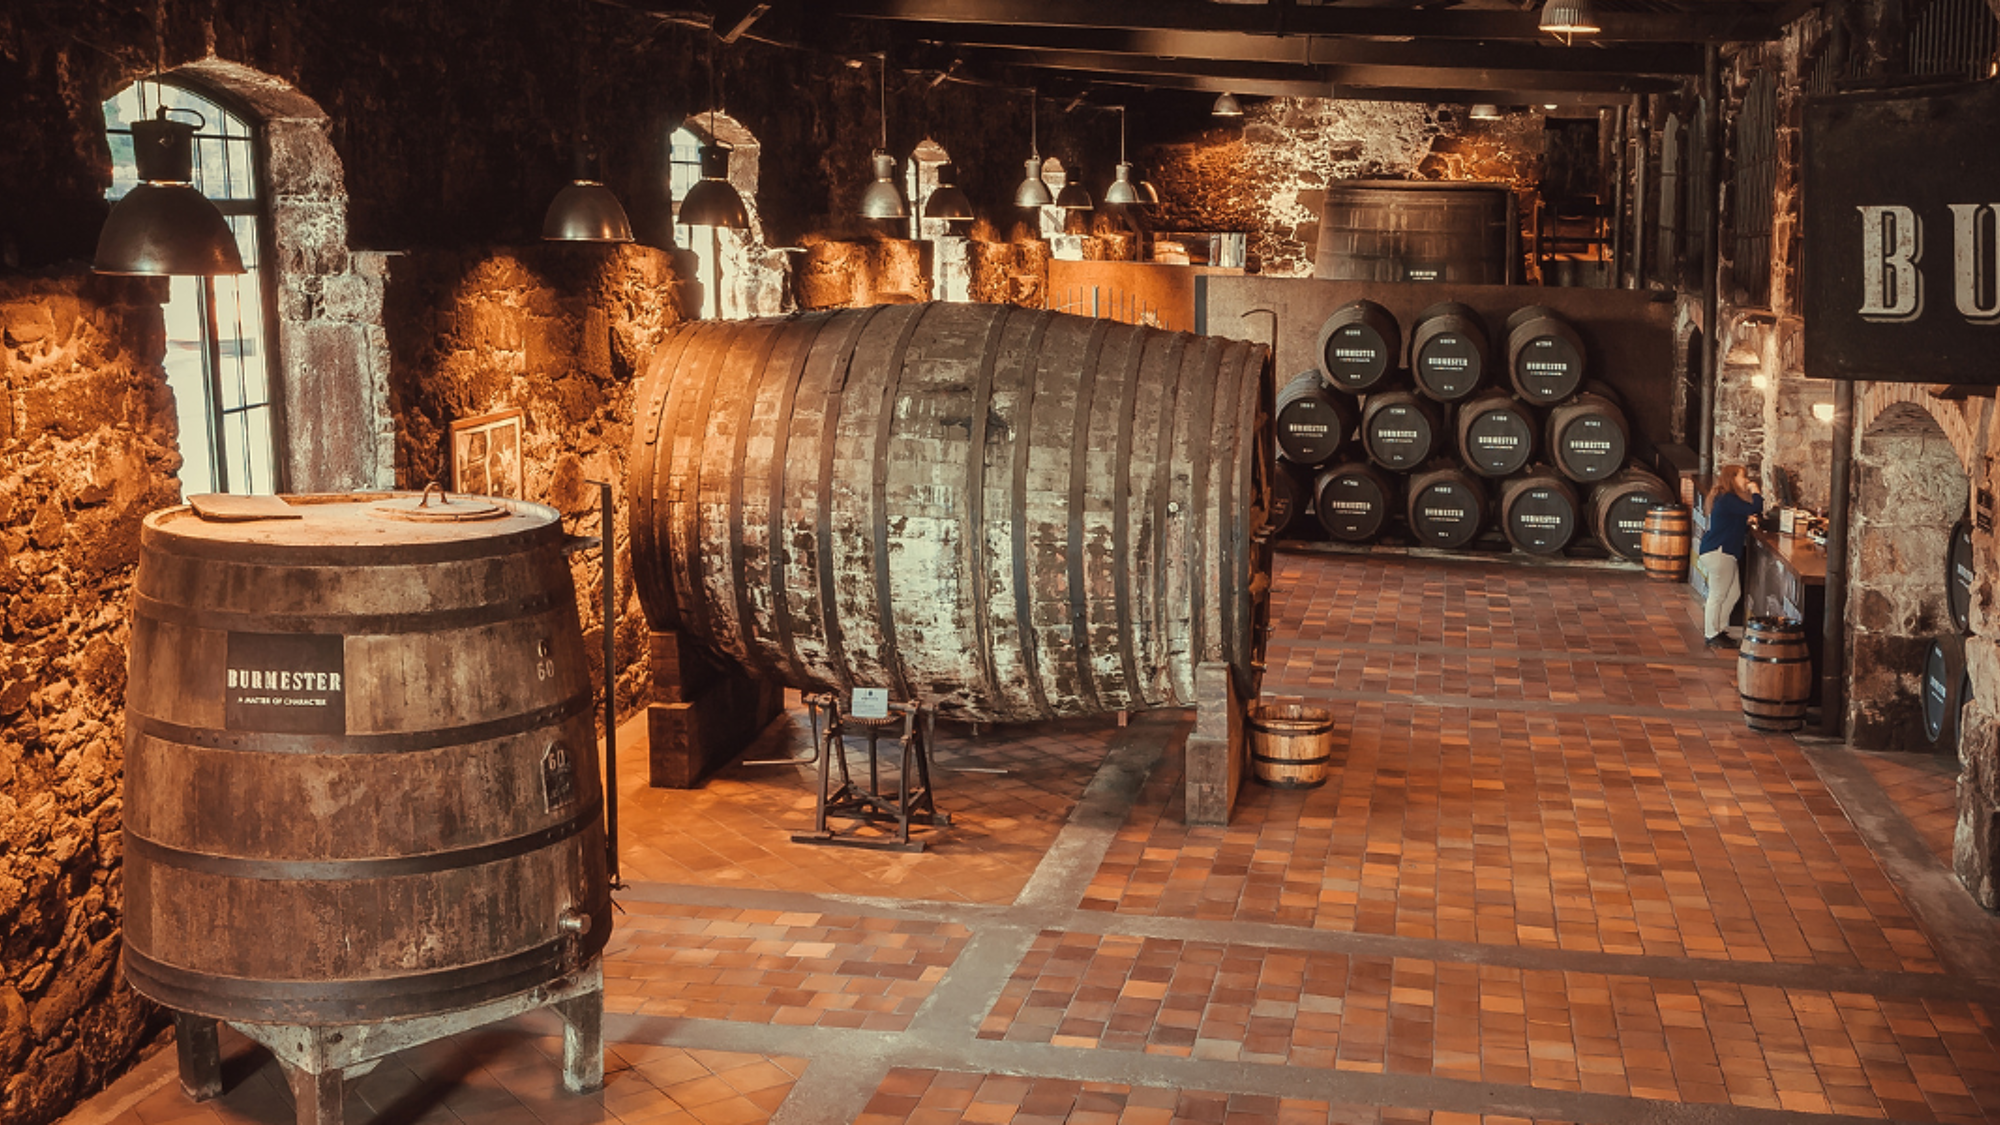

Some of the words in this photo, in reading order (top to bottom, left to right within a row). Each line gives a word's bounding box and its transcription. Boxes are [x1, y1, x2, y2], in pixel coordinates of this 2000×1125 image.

[227, 669, 341, 691] BURMESTER
[537, 658, 554, 681] 60
[272, 697, 282, 705] OF
[283, 698, 327, 706] CHARACTER
